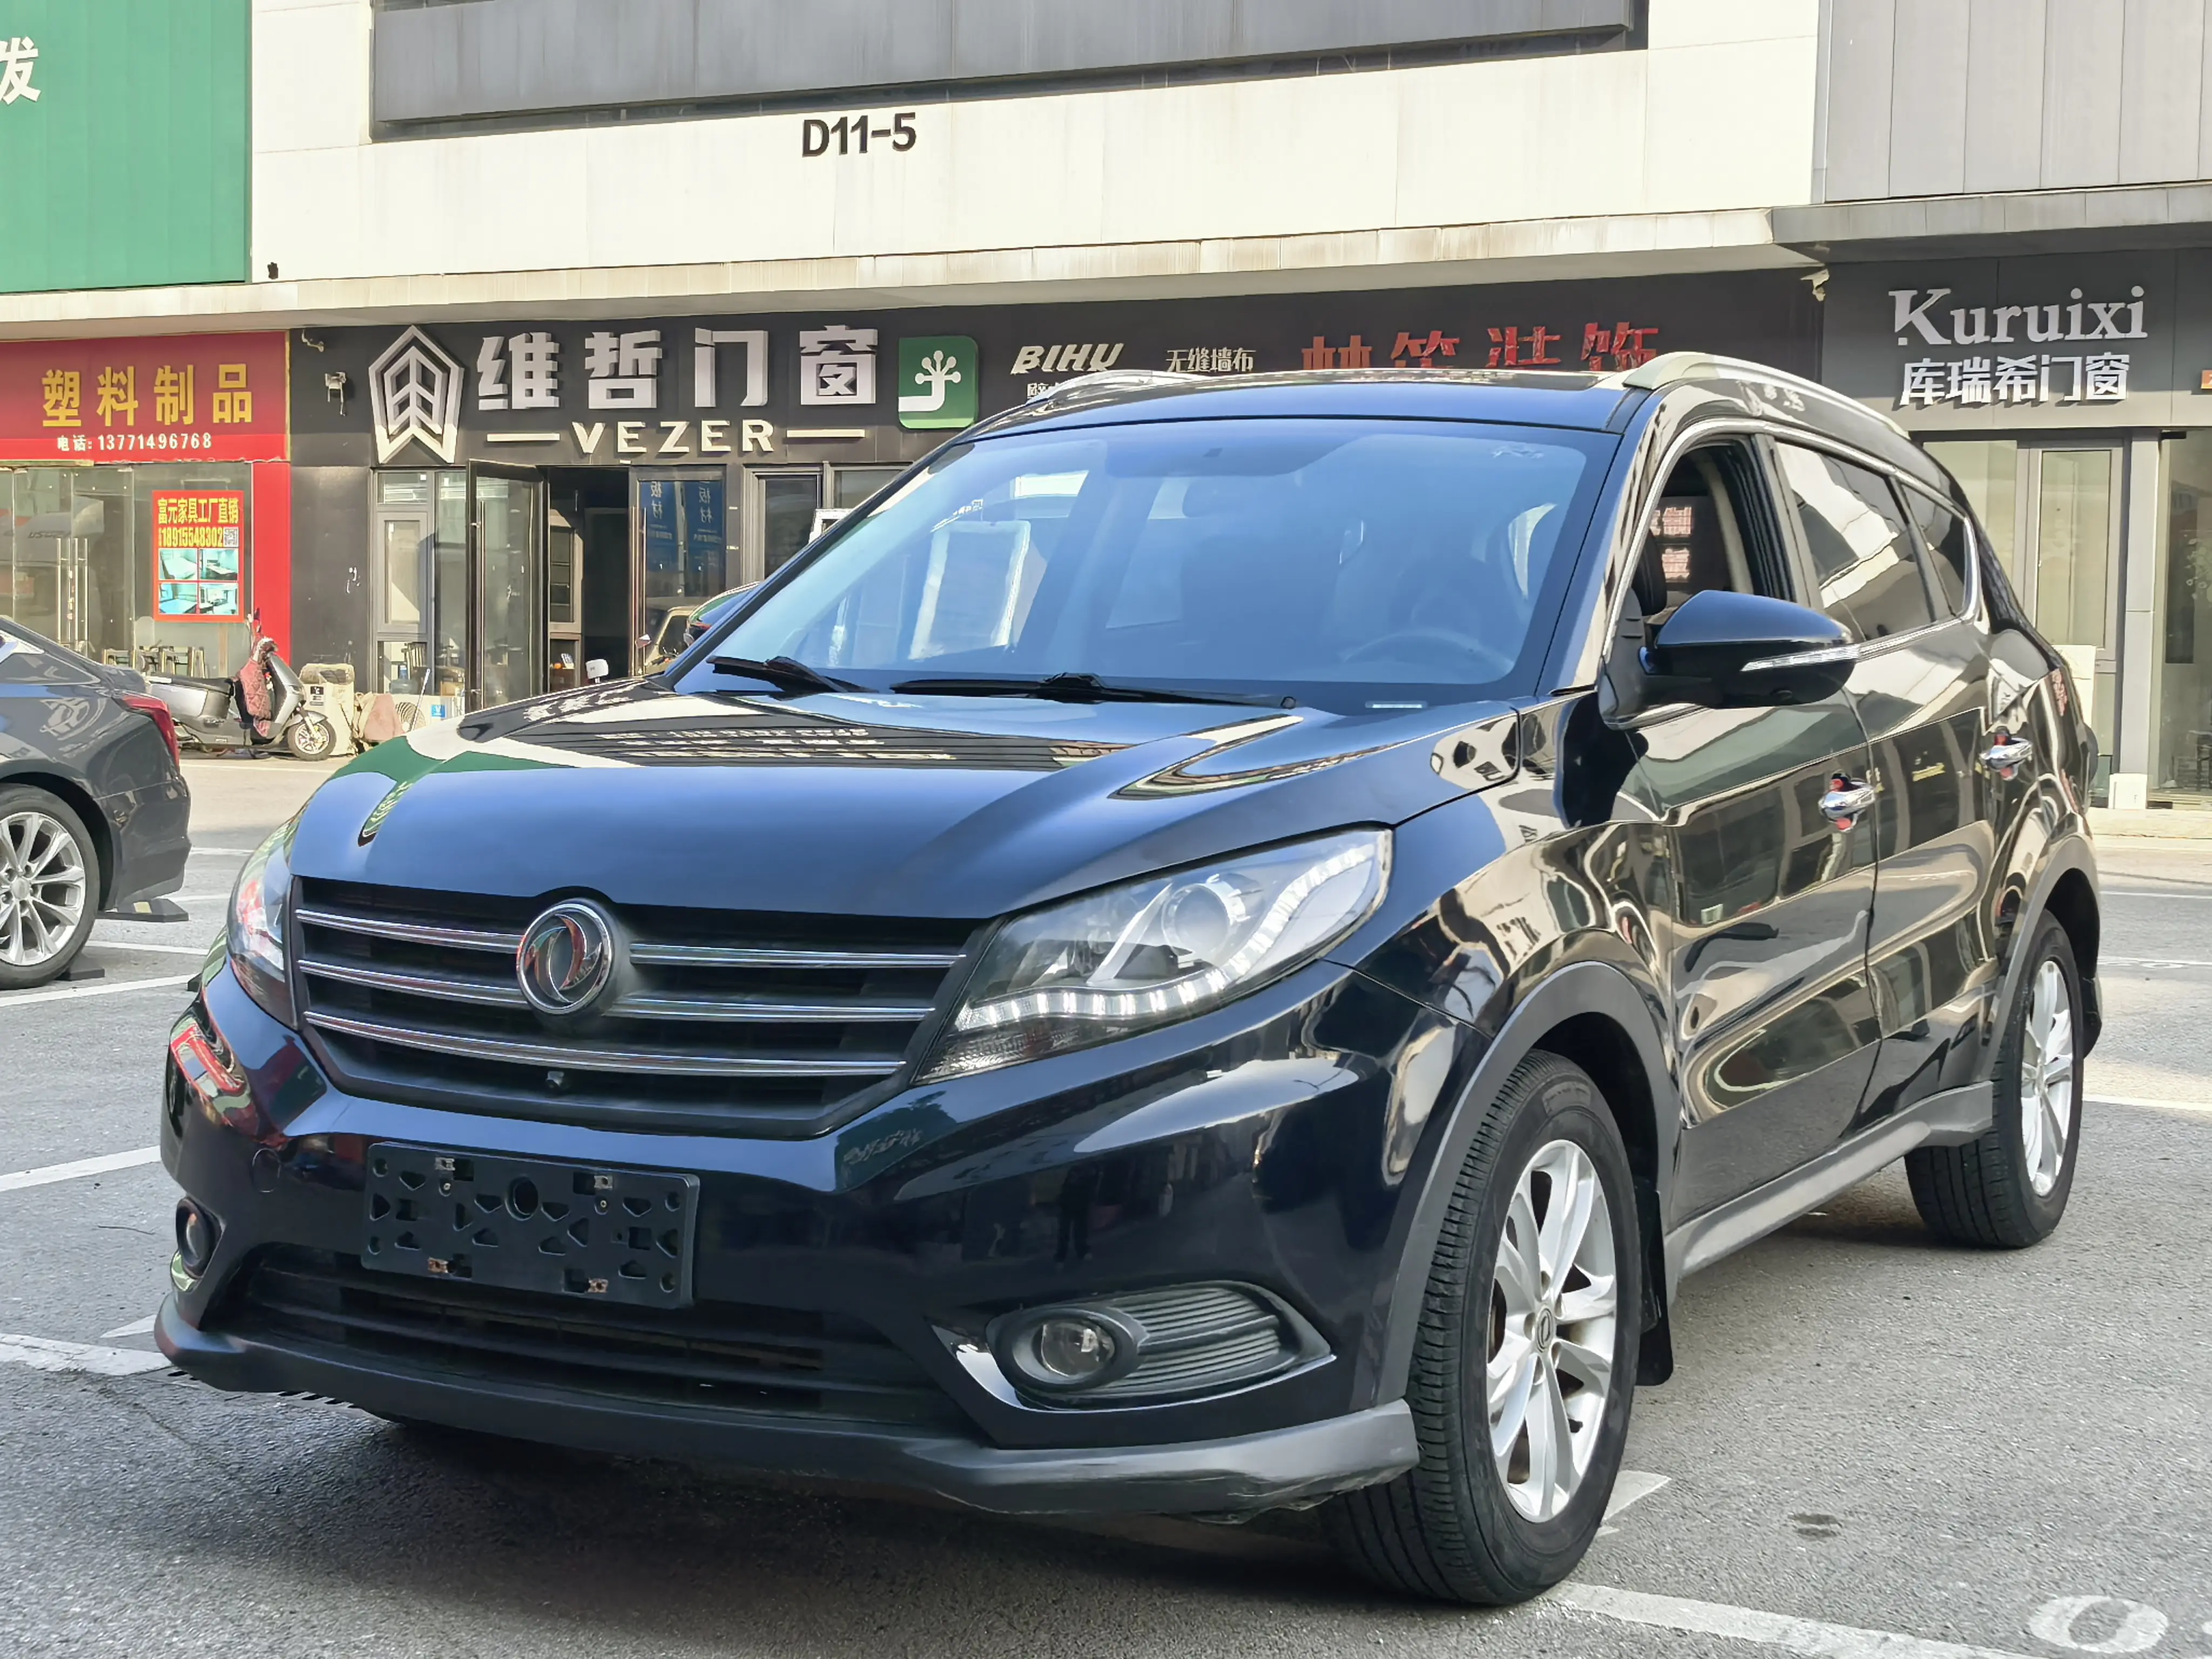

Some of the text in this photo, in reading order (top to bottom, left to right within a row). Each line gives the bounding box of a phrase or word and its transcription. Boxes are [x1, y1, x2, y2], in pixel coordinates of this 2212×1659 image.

[802, 112, 916, 158] D11-5
[1888, 286, 2148, 346] Kuruixi
[477, 325, 879, 410] 维哲门窗
[1010, 342, 1124, 375] BIHU
[1165, 347, 1256, 373] 无缝墙布
[1899, 352, 2130, 406] 库瑞希门窗
[42, 364, 252, 427] 塑料制品
[572, 419, 774, 454] VEZER
